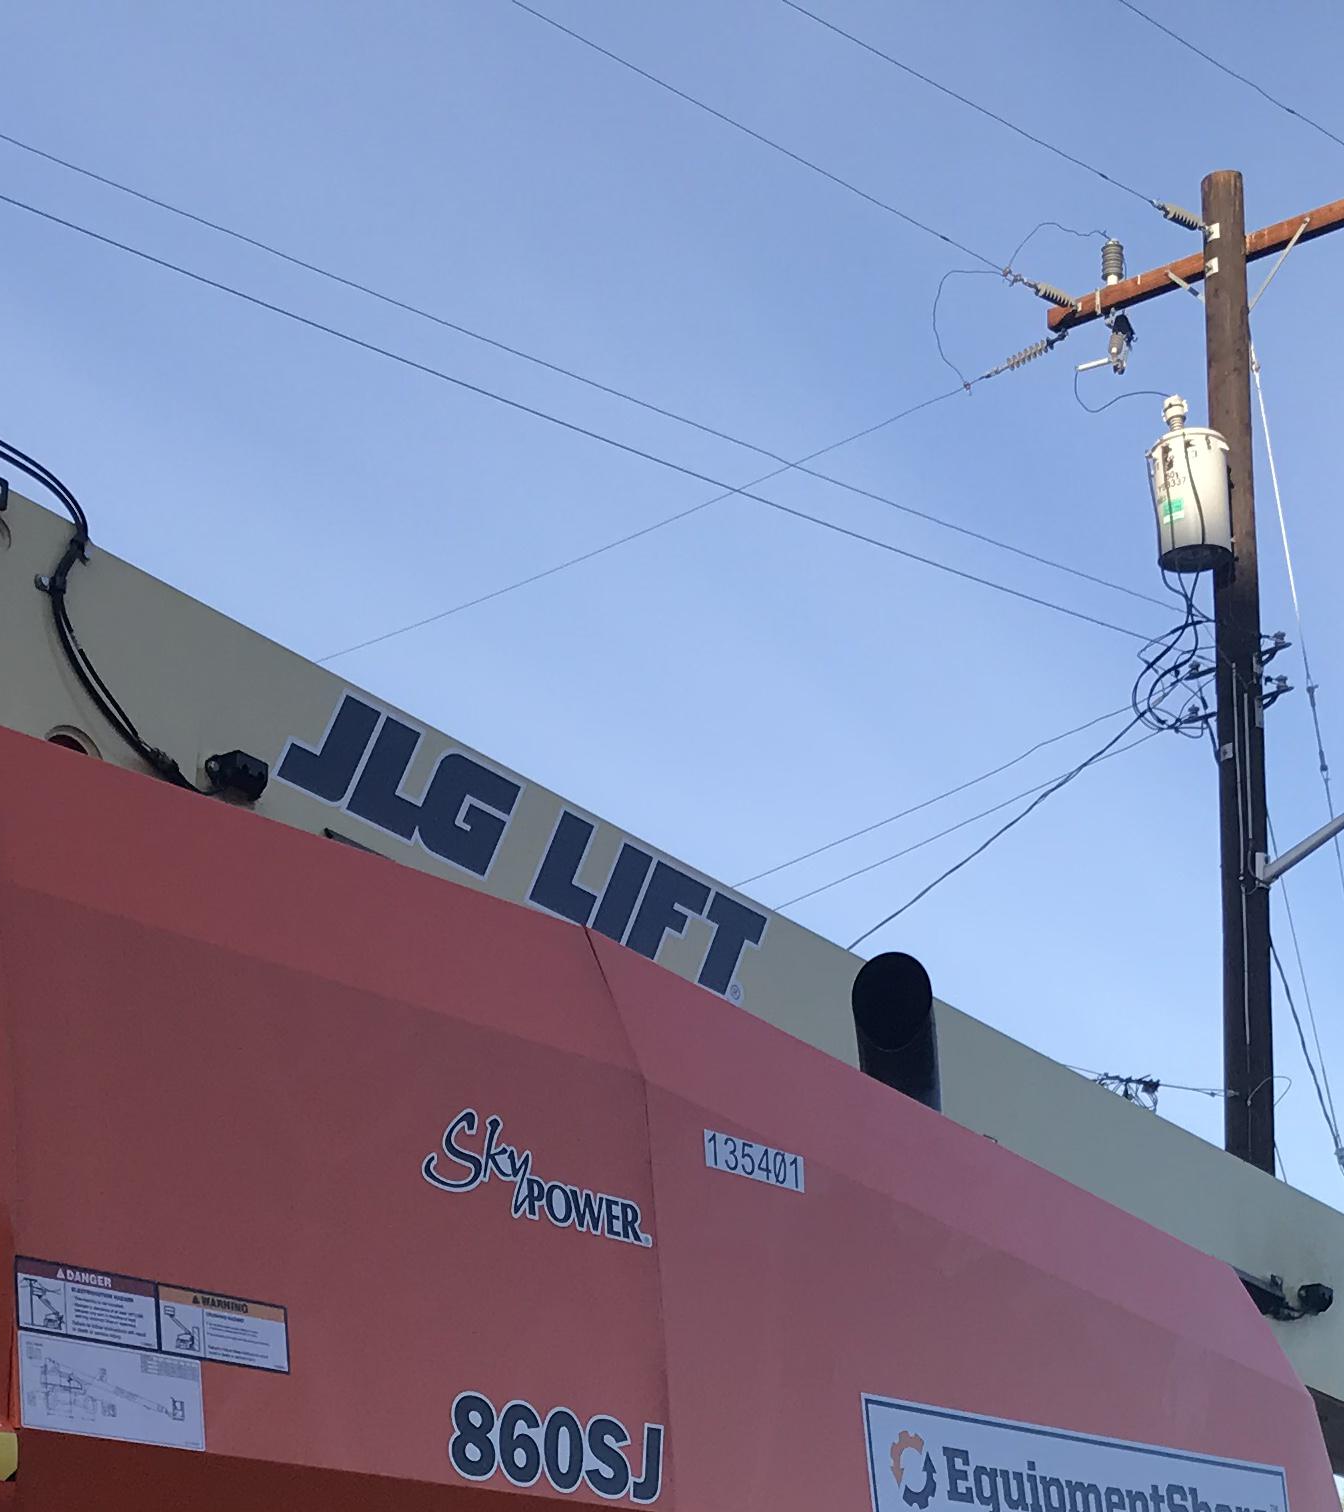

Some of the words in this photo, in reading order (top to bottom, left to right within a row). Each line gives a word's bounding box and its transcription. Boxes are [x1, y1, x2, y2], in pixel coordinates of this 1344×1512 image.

[273, 692, 523, 880] JLG
[528, 808, 768, 996] LIFT
[422, 1110, 531, 1216] Sky
[526, 1177, 643, 1243] POWER
[708, 1132, 799, 1189] 135401
[66, 1269, 112, 1288] DANGER
[201, 1295, 249, 1314] WARNING
[452, 1393, 663, 1503] 860SJ
